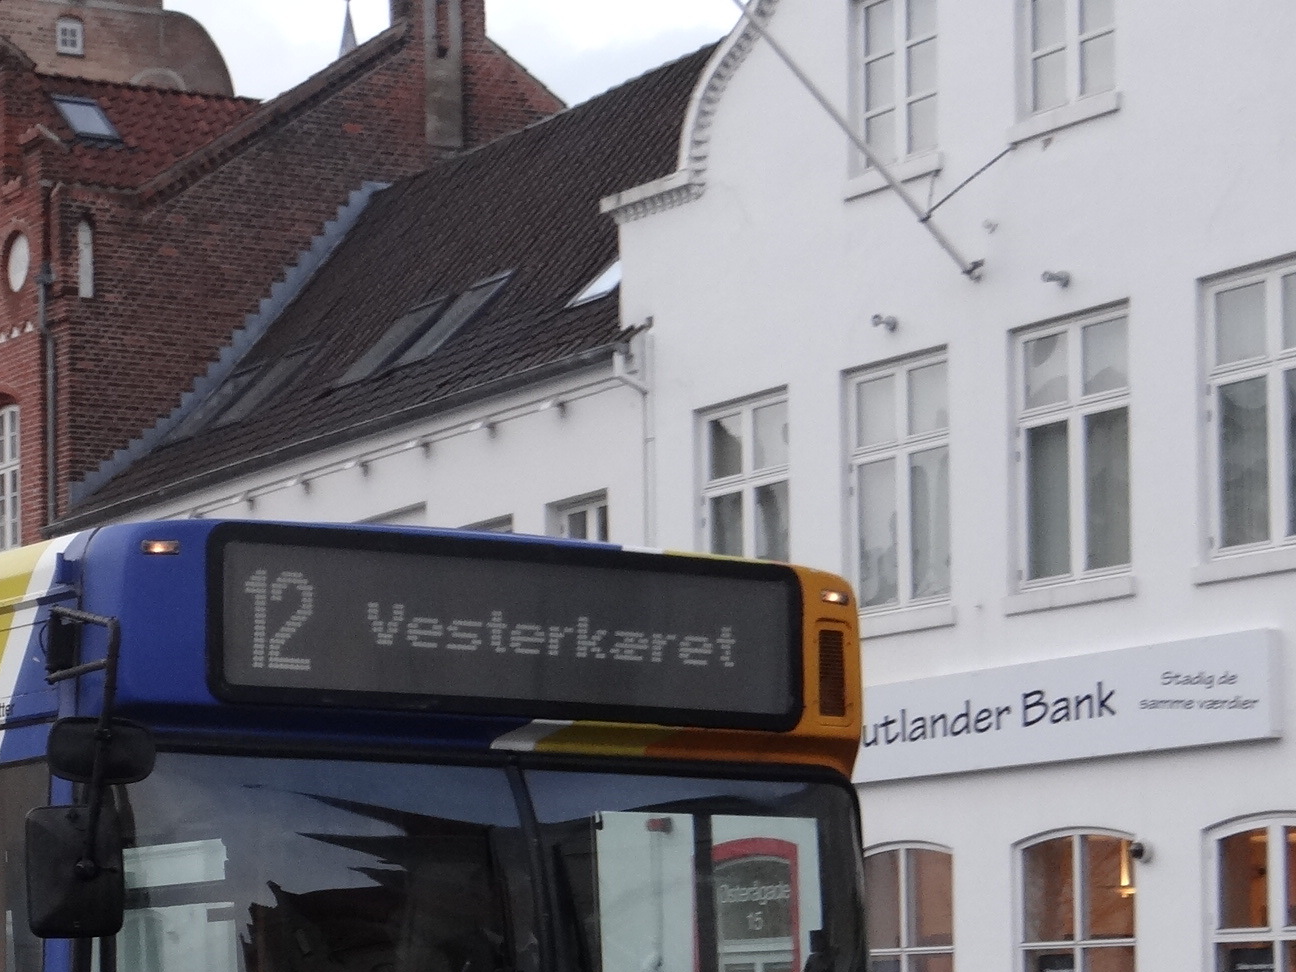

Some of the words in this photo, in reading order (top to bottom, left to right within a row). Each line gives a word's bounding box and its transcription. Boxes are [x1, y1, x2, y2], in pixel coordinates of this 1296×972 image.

[244, 568, 315, 672] 12
[366, 601, 736, 668] Vesterkæret
[1160, 671, 1215, 689] Stadig
[1218, 671, 1238, 685] de
[862, 700, 1011, 748] utlander
[1021, 681, 1117, 729] Bank
